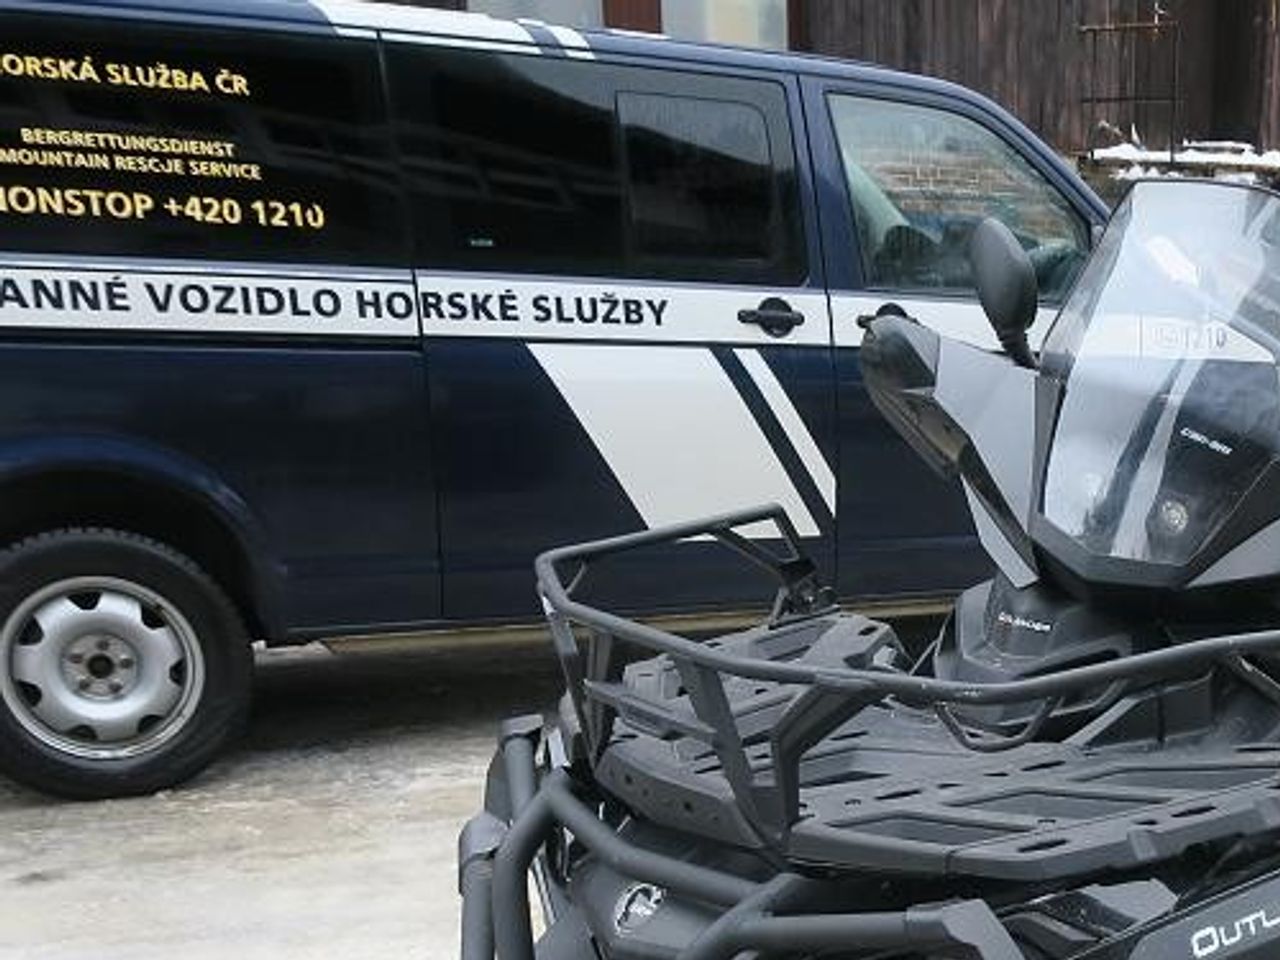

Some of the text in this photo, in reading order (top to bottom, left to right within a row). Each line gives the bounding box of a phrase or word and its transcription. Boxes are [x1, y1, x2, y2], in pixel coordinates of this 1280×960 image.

[0, 54, 250, 96] ORSKÁ SLUŽBA ČR
[20, 127, 235, 158] BERGRETTUNGSDIENST
[0, 149, 110, 170] MOUNTAIN
[189, 161, 262, 181] SERVICE
[163, 196, 242, 225] +420
[250, 201, 325, 230] 1210
[144, 282, 342, 318] VOZIDLO
[356, 289, 520, 321] HORSKÉ
[532, 292, 669, 326] SLUŽBY
